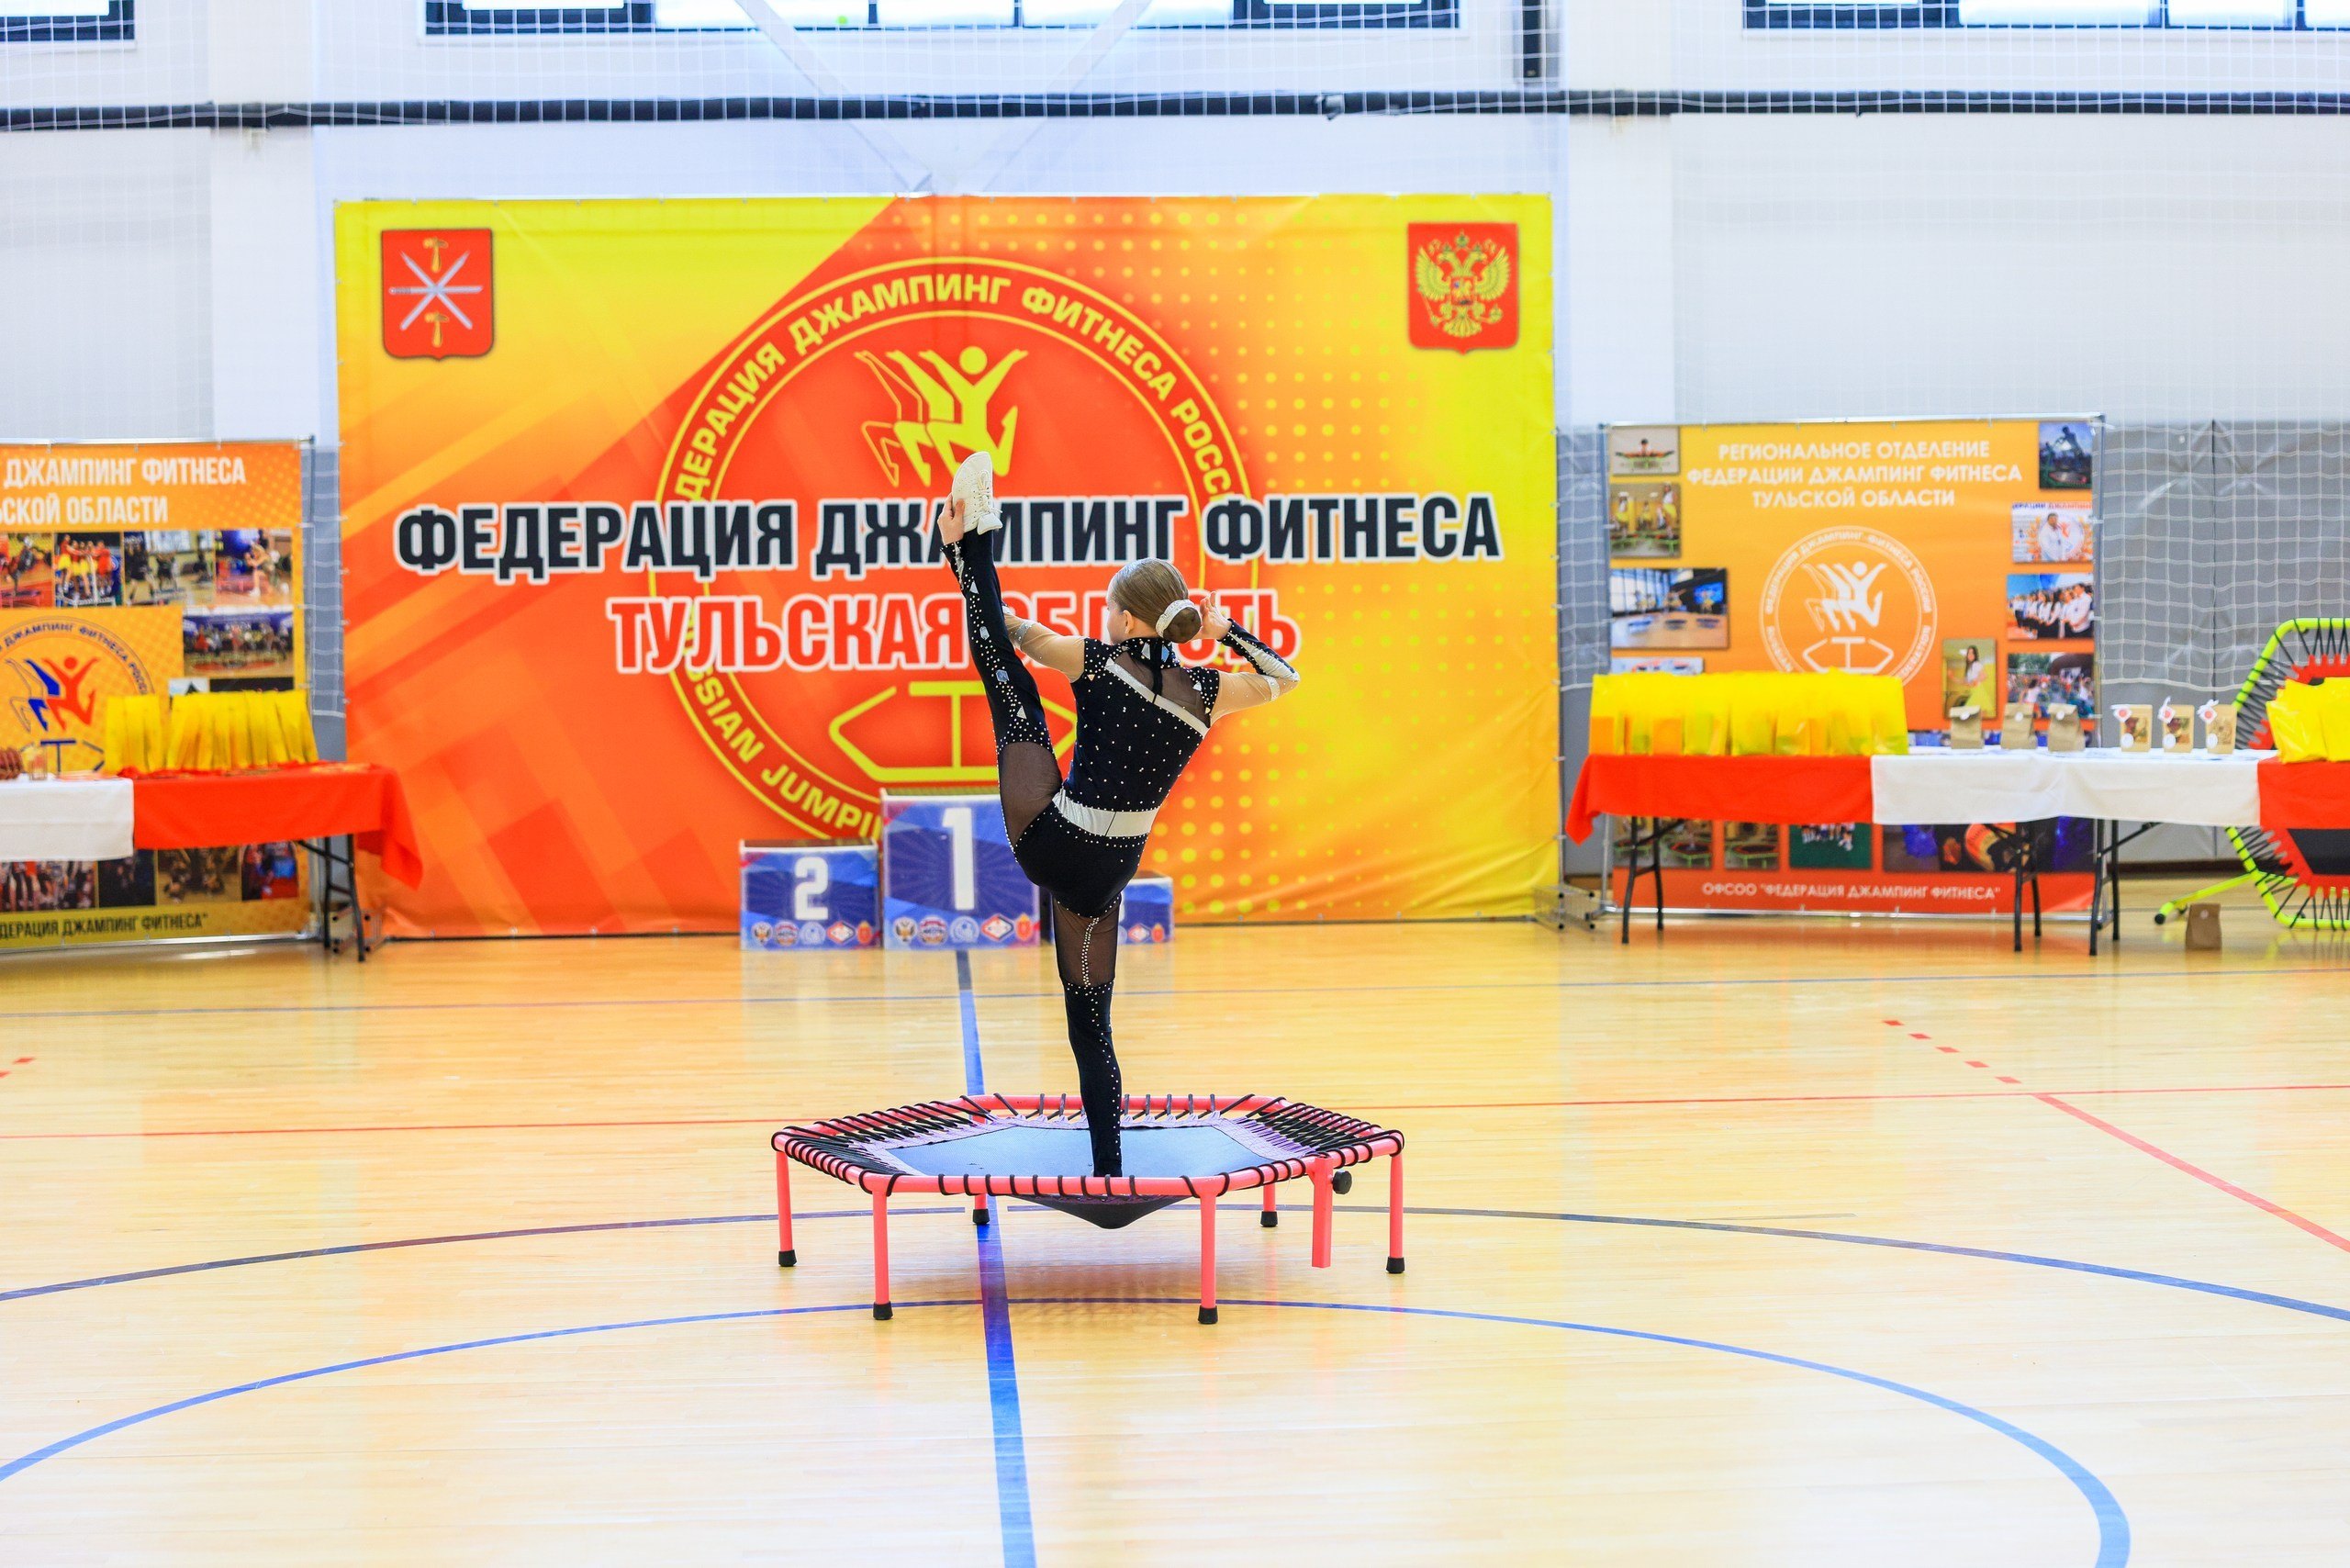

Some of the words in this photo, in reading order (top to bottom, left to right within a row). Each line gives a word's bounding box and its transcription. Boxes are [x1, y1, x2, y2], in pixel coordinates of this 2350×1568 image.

[789, 273, 1011, 356] ДЖАМПИНГ
[1022, 286, 1177, 400] ФИТНЕСА
[1718, 442, 1871, 461] РЕГИОНАЛЬНОЕ
[1875, 441, 1990, 459] ОТДЕЛЕНИЕ
[4, 457, 137, 489] ДЖАМПИНГ
[141, 456, 246, 485] ФИТНЕСА
[1686, 466, 1803, 486] ФЕДЕРАЦИИ
[1808, 465, 1925, 486] ДЖАМПИНГ
[1930, 465, 2022, 483] ФИТНЕСА
[0, 492, 61, 526] СКОЙ
[66, 496, 168, 524] ОБЛАСТИ
[1752, 487, 1855, 508] ТУЛЬСКОЙ
[1861, 489, 1955, 507] ОБЛАСТИ
[395, 499, 797, 584] ФЕДЕРАЦИЯ
[1203, 493, 1504, 564] ФИТНЕСА
[606, 592, 968, 674] ТУЛЬСКАЯ
[942, 807, 975, 911] 1
[794, 856, 829, 921] 2
[1847, 884, 1927, 900] ДЖАМПИНГ
[62, 916, 138, 936] ДЖАМПИНГ
